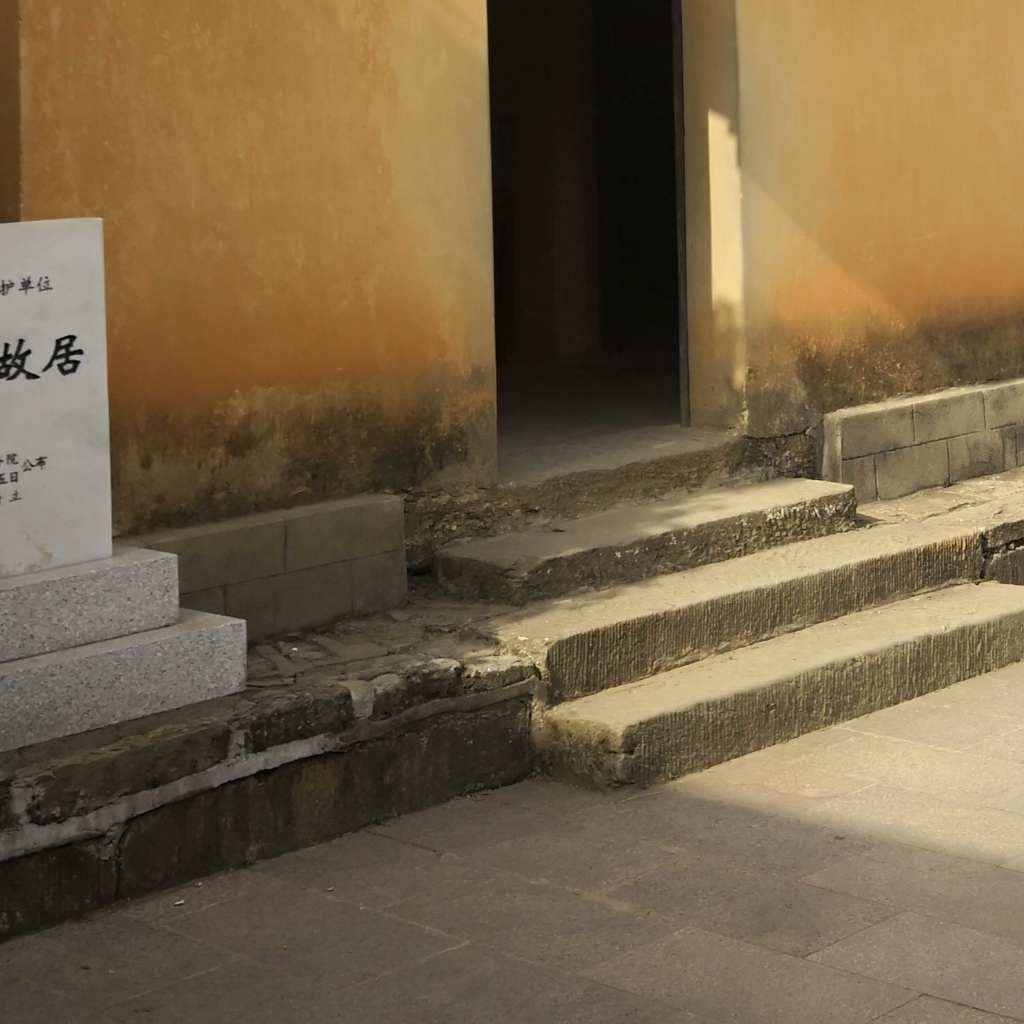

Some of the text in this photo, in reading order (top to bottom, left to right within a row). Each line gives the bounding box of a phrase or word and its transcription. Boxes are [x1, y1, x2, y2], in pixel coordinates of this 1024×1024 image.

[0, 276, 53, 296] 护单位
[0, 335, 84, 381] 故居
